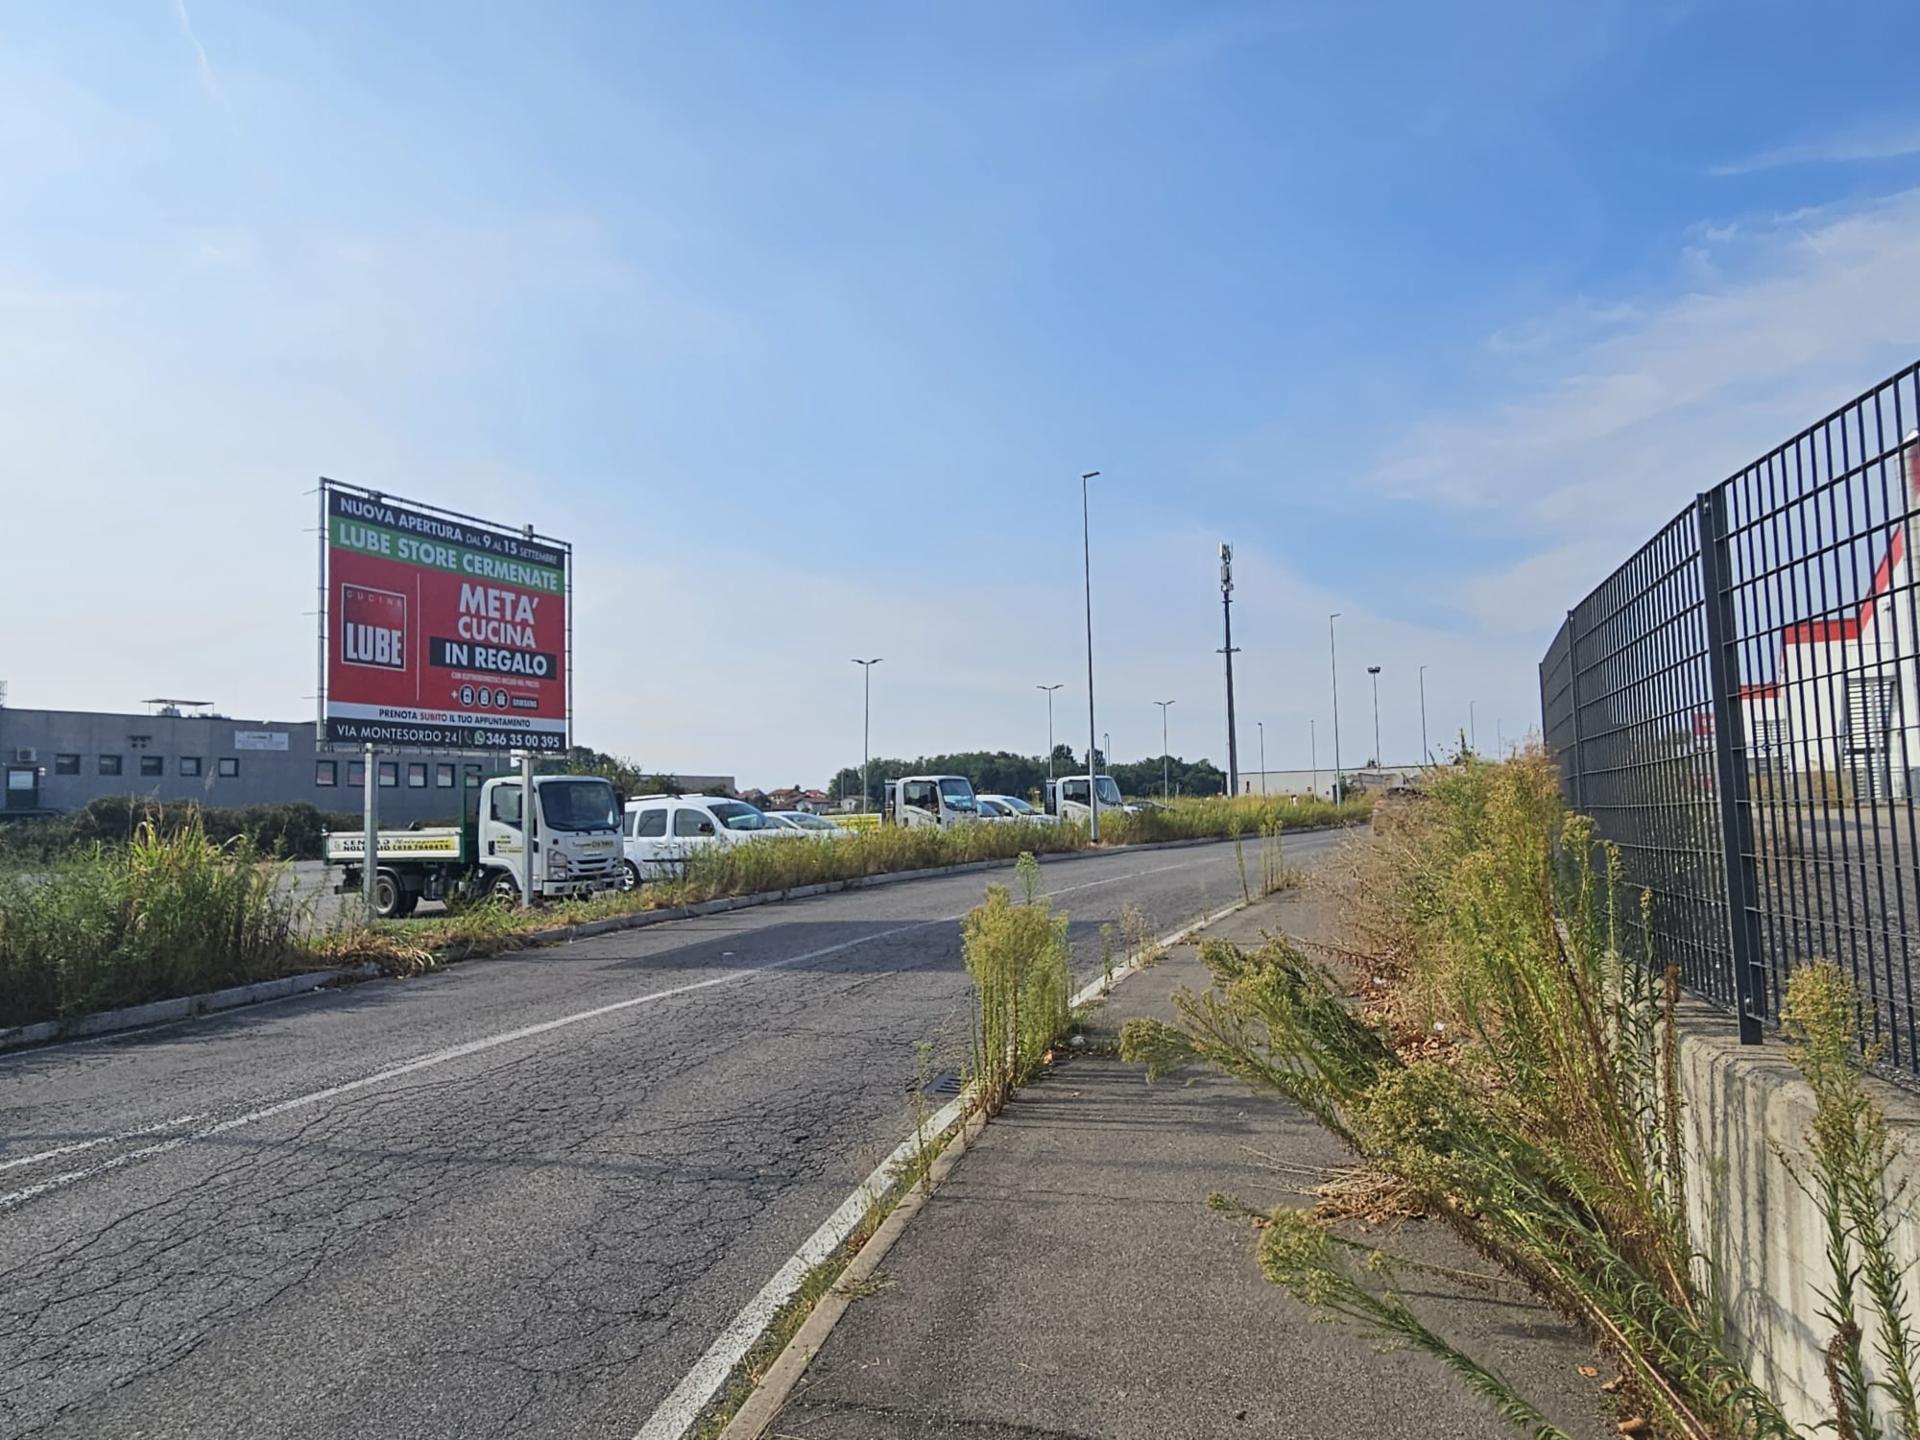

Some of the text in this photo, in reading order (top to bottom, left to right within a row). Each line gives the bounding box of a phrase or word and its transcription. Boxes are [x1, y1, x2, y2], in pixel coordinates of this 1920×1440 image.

[340, 497, 558, 565] NUOVA APERTURA DAL 9 AL 15 SETTEMBRE
[339, 523, 558, 591] LUBE STORE CERMENATE
[346, 622, 402, 665] LUBE
[457, 615, 537, 649] CUCINA
[445, 642, 548, 676] IN REGALO
[379, 709, 530, 728] PRENOTA SUBITO IL TUO APPUNTAMENTO
[336, 724, 560, 748] VIA MONTESORDO 24 346 35 00 395
